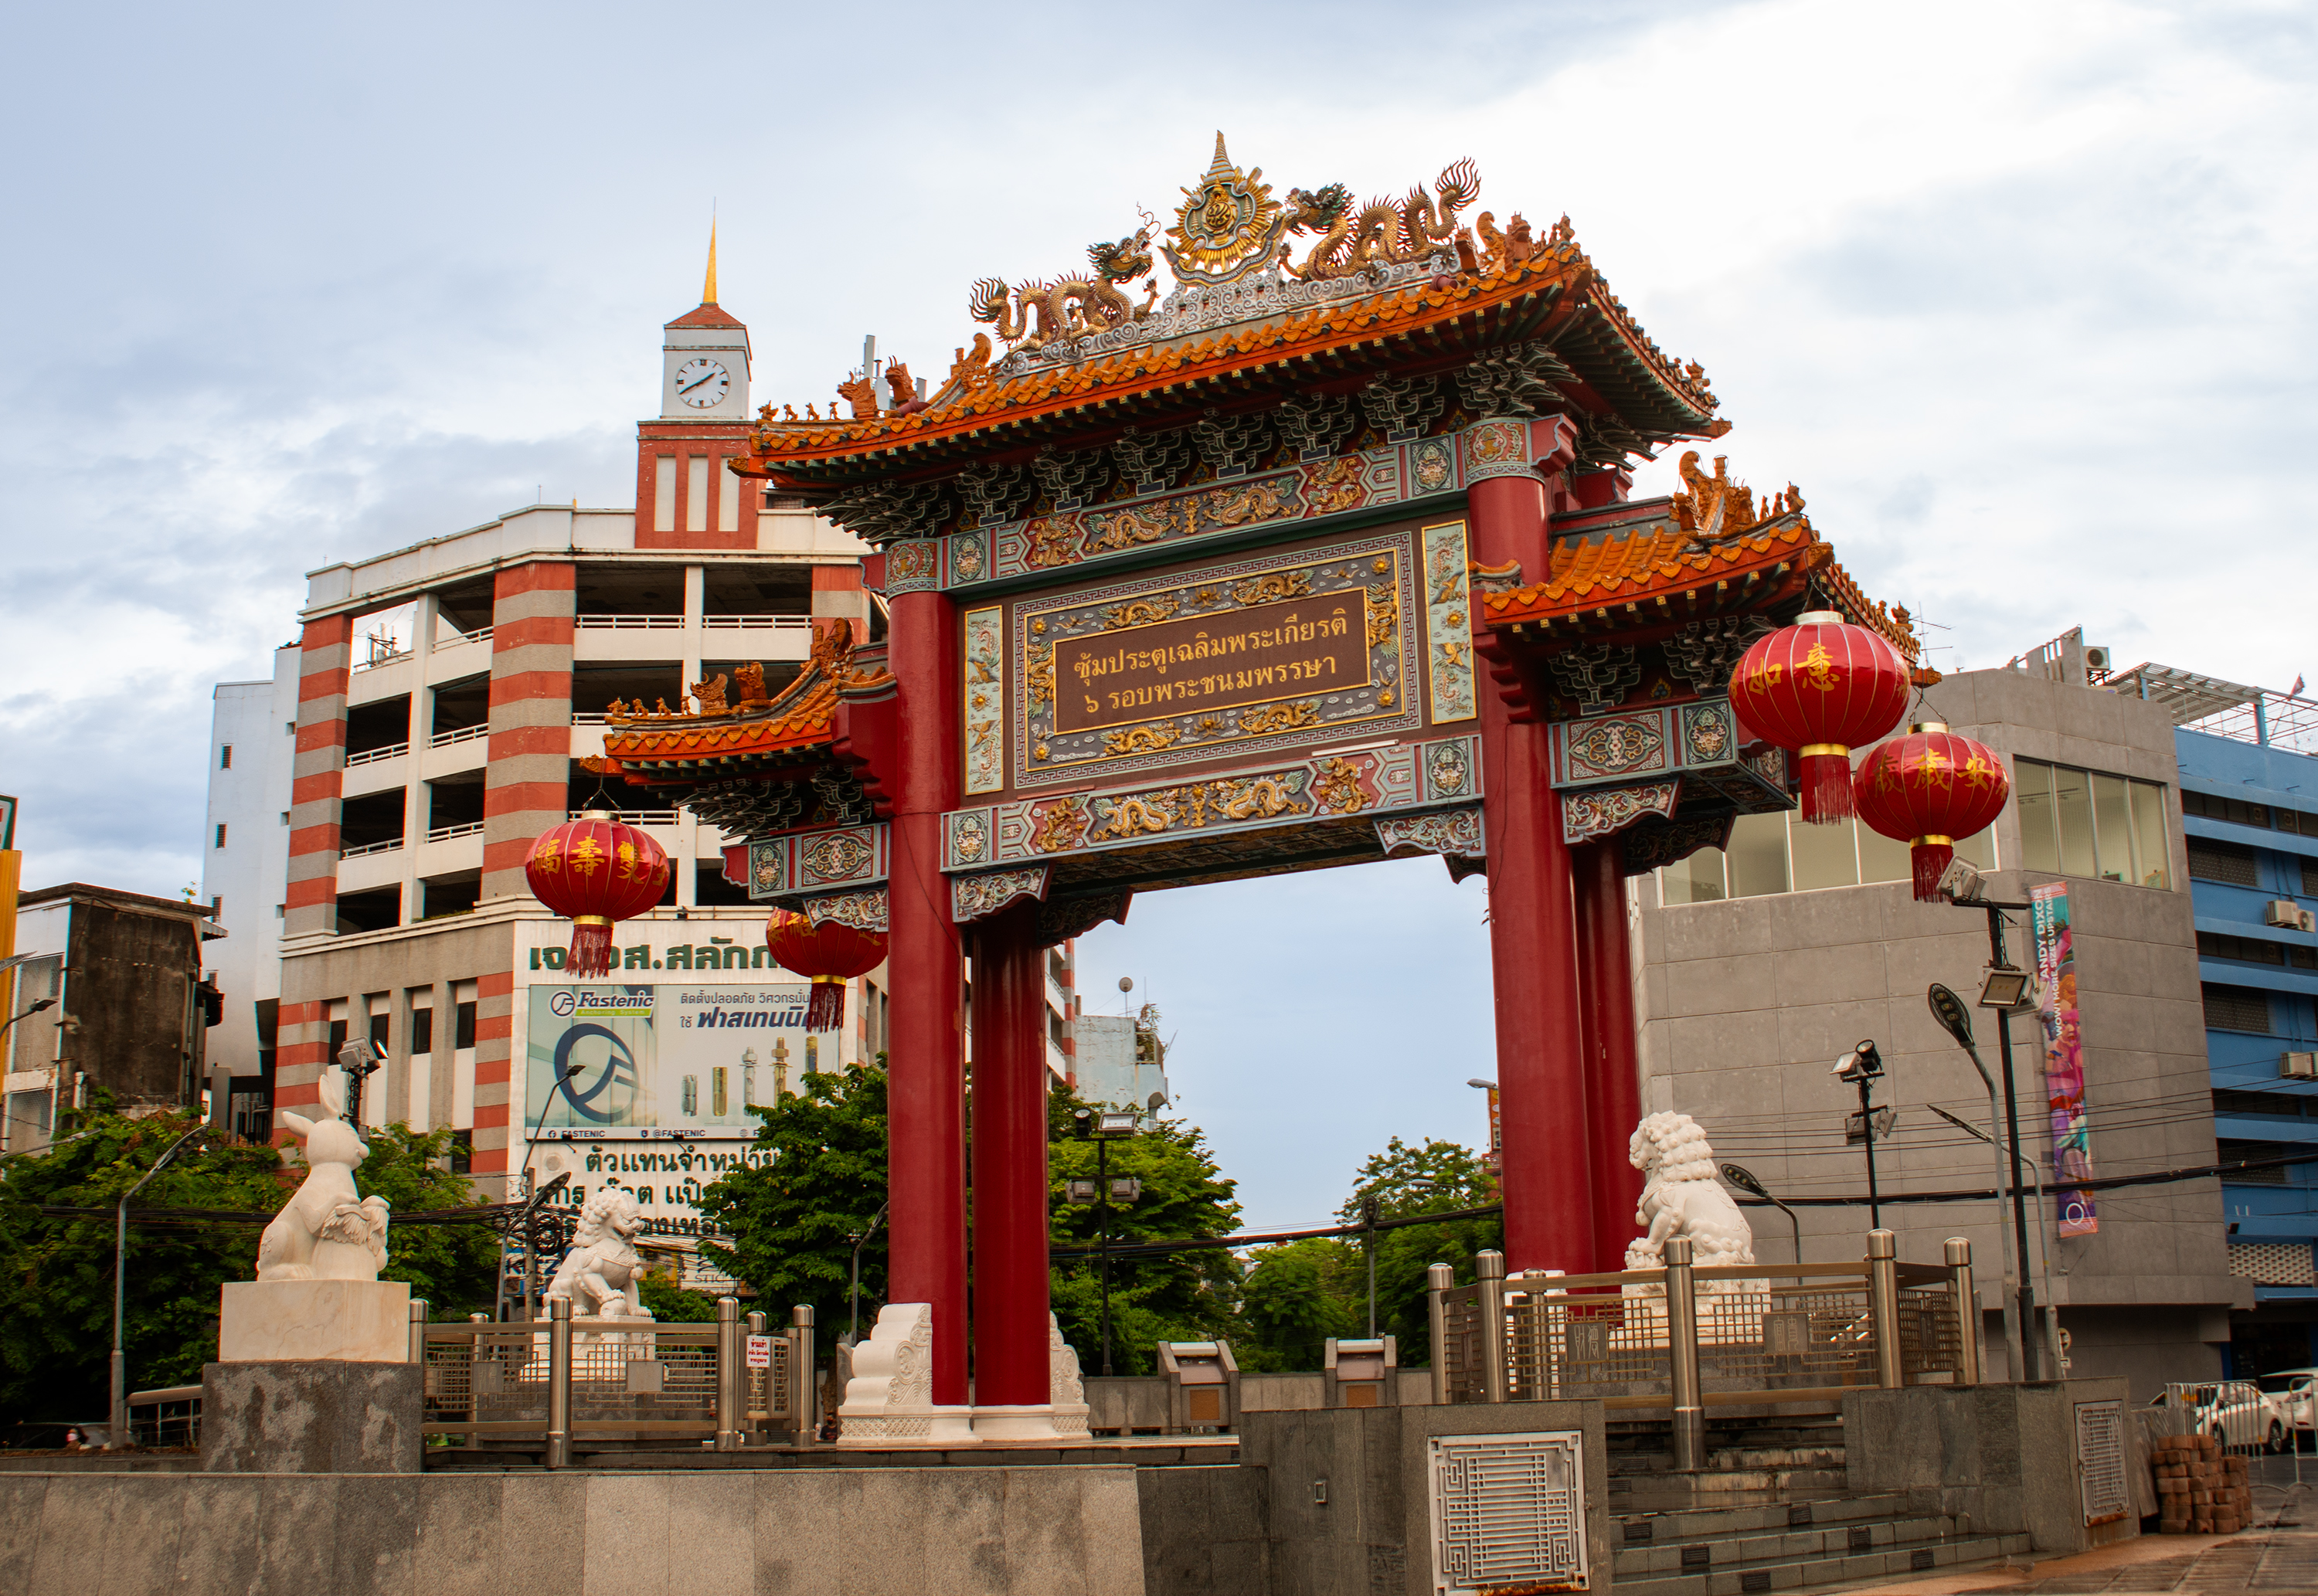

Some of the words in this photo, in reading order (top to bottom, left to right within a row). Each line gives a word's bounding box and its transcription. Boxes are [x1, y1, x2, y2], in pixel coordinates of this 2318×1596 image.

[1074, 608, 1347, 687] ซุ้มประตูเฉลิมพระเกียรติ
[1084, 694, 1100, 713] ๖
[1108, 656, 1336, 709] รอบพระชนมพรรษา
[2034, 888, 2046, 936] DIXON
[2045, 886, 2055, 936] UPSTAIRS
[2038, 939, 2050, 980] ANDY
[2048, 938, 2058, 968] SIZES
[577, 991, 655, 1007] Fastenic
[680, 990, 756, 1004] ติดตั้งปลอดภัย
[759, 989, 811, 1004] วิศวกรมั่น
[2051, 969, 2061, 1000] MORE
[680, 1016, 692, 1028] ใช้
